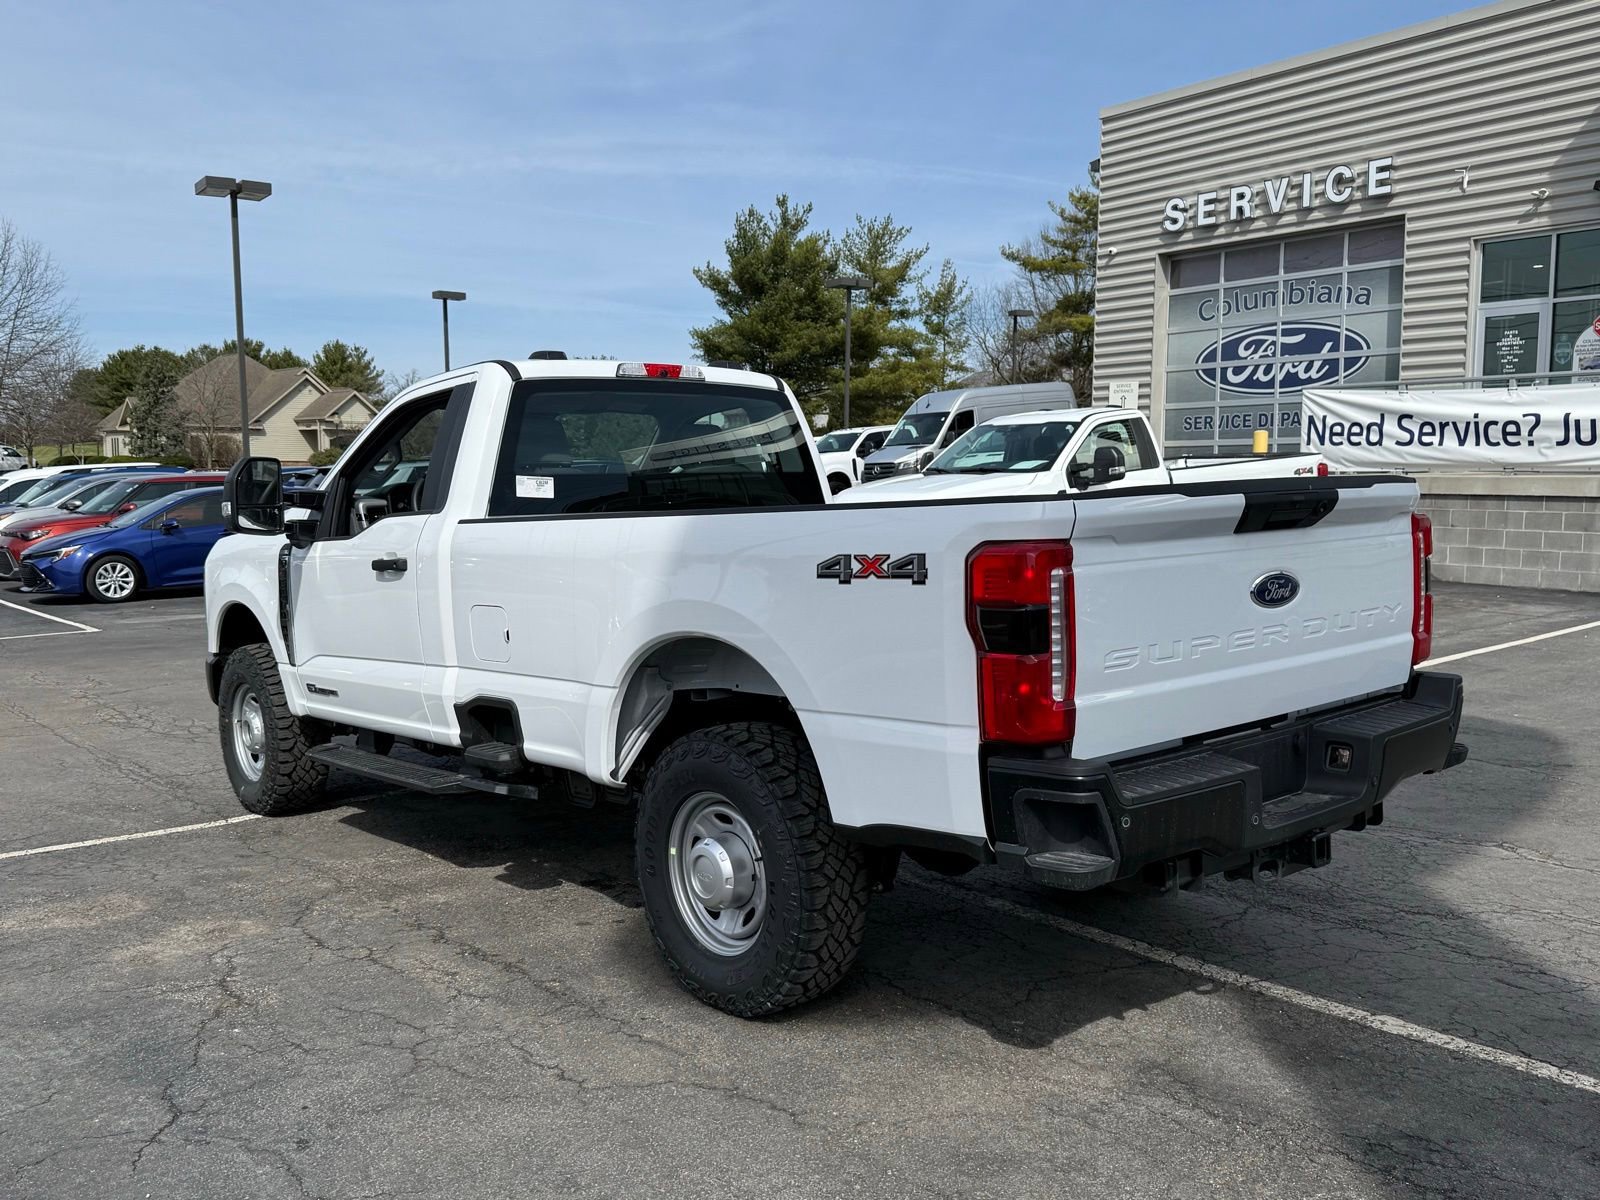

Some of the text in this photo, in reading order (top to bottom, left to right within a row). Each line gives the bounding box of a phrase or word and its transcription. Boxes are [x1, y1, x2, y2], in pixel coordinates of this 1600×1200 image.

[1162, 156, 1394, 232] SERVICE
[1198, 280, 1373, 322] Columbiana
[1226, 333, 1334, 384] Ford
[1306, 412, 1598, 447] Need Service? Ju
[1265, 579, 1291, 600] Ford
[1103, 602, 1402, 674] SUPER DUTY
